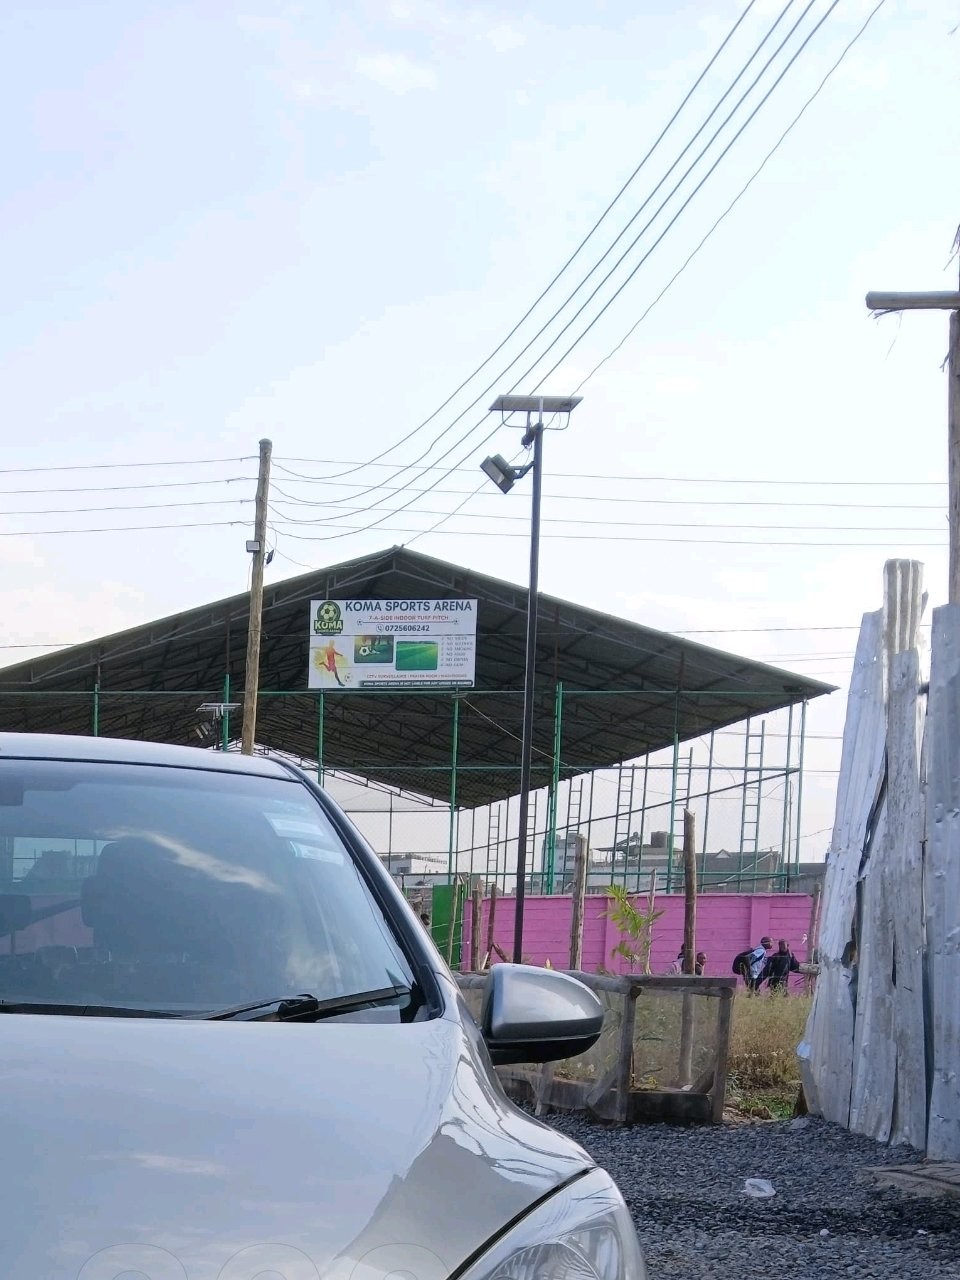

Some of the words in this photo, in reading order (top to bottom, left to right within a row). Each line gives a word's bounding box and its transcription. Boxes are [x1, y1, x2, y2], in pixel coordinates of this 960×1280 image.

[345, 601, 382, 611] KOMA
[385, 601, 430, 611] SPORTS
[434, 601, 472, 611] ARENA
[314, 620, 343, 630] KOMA
